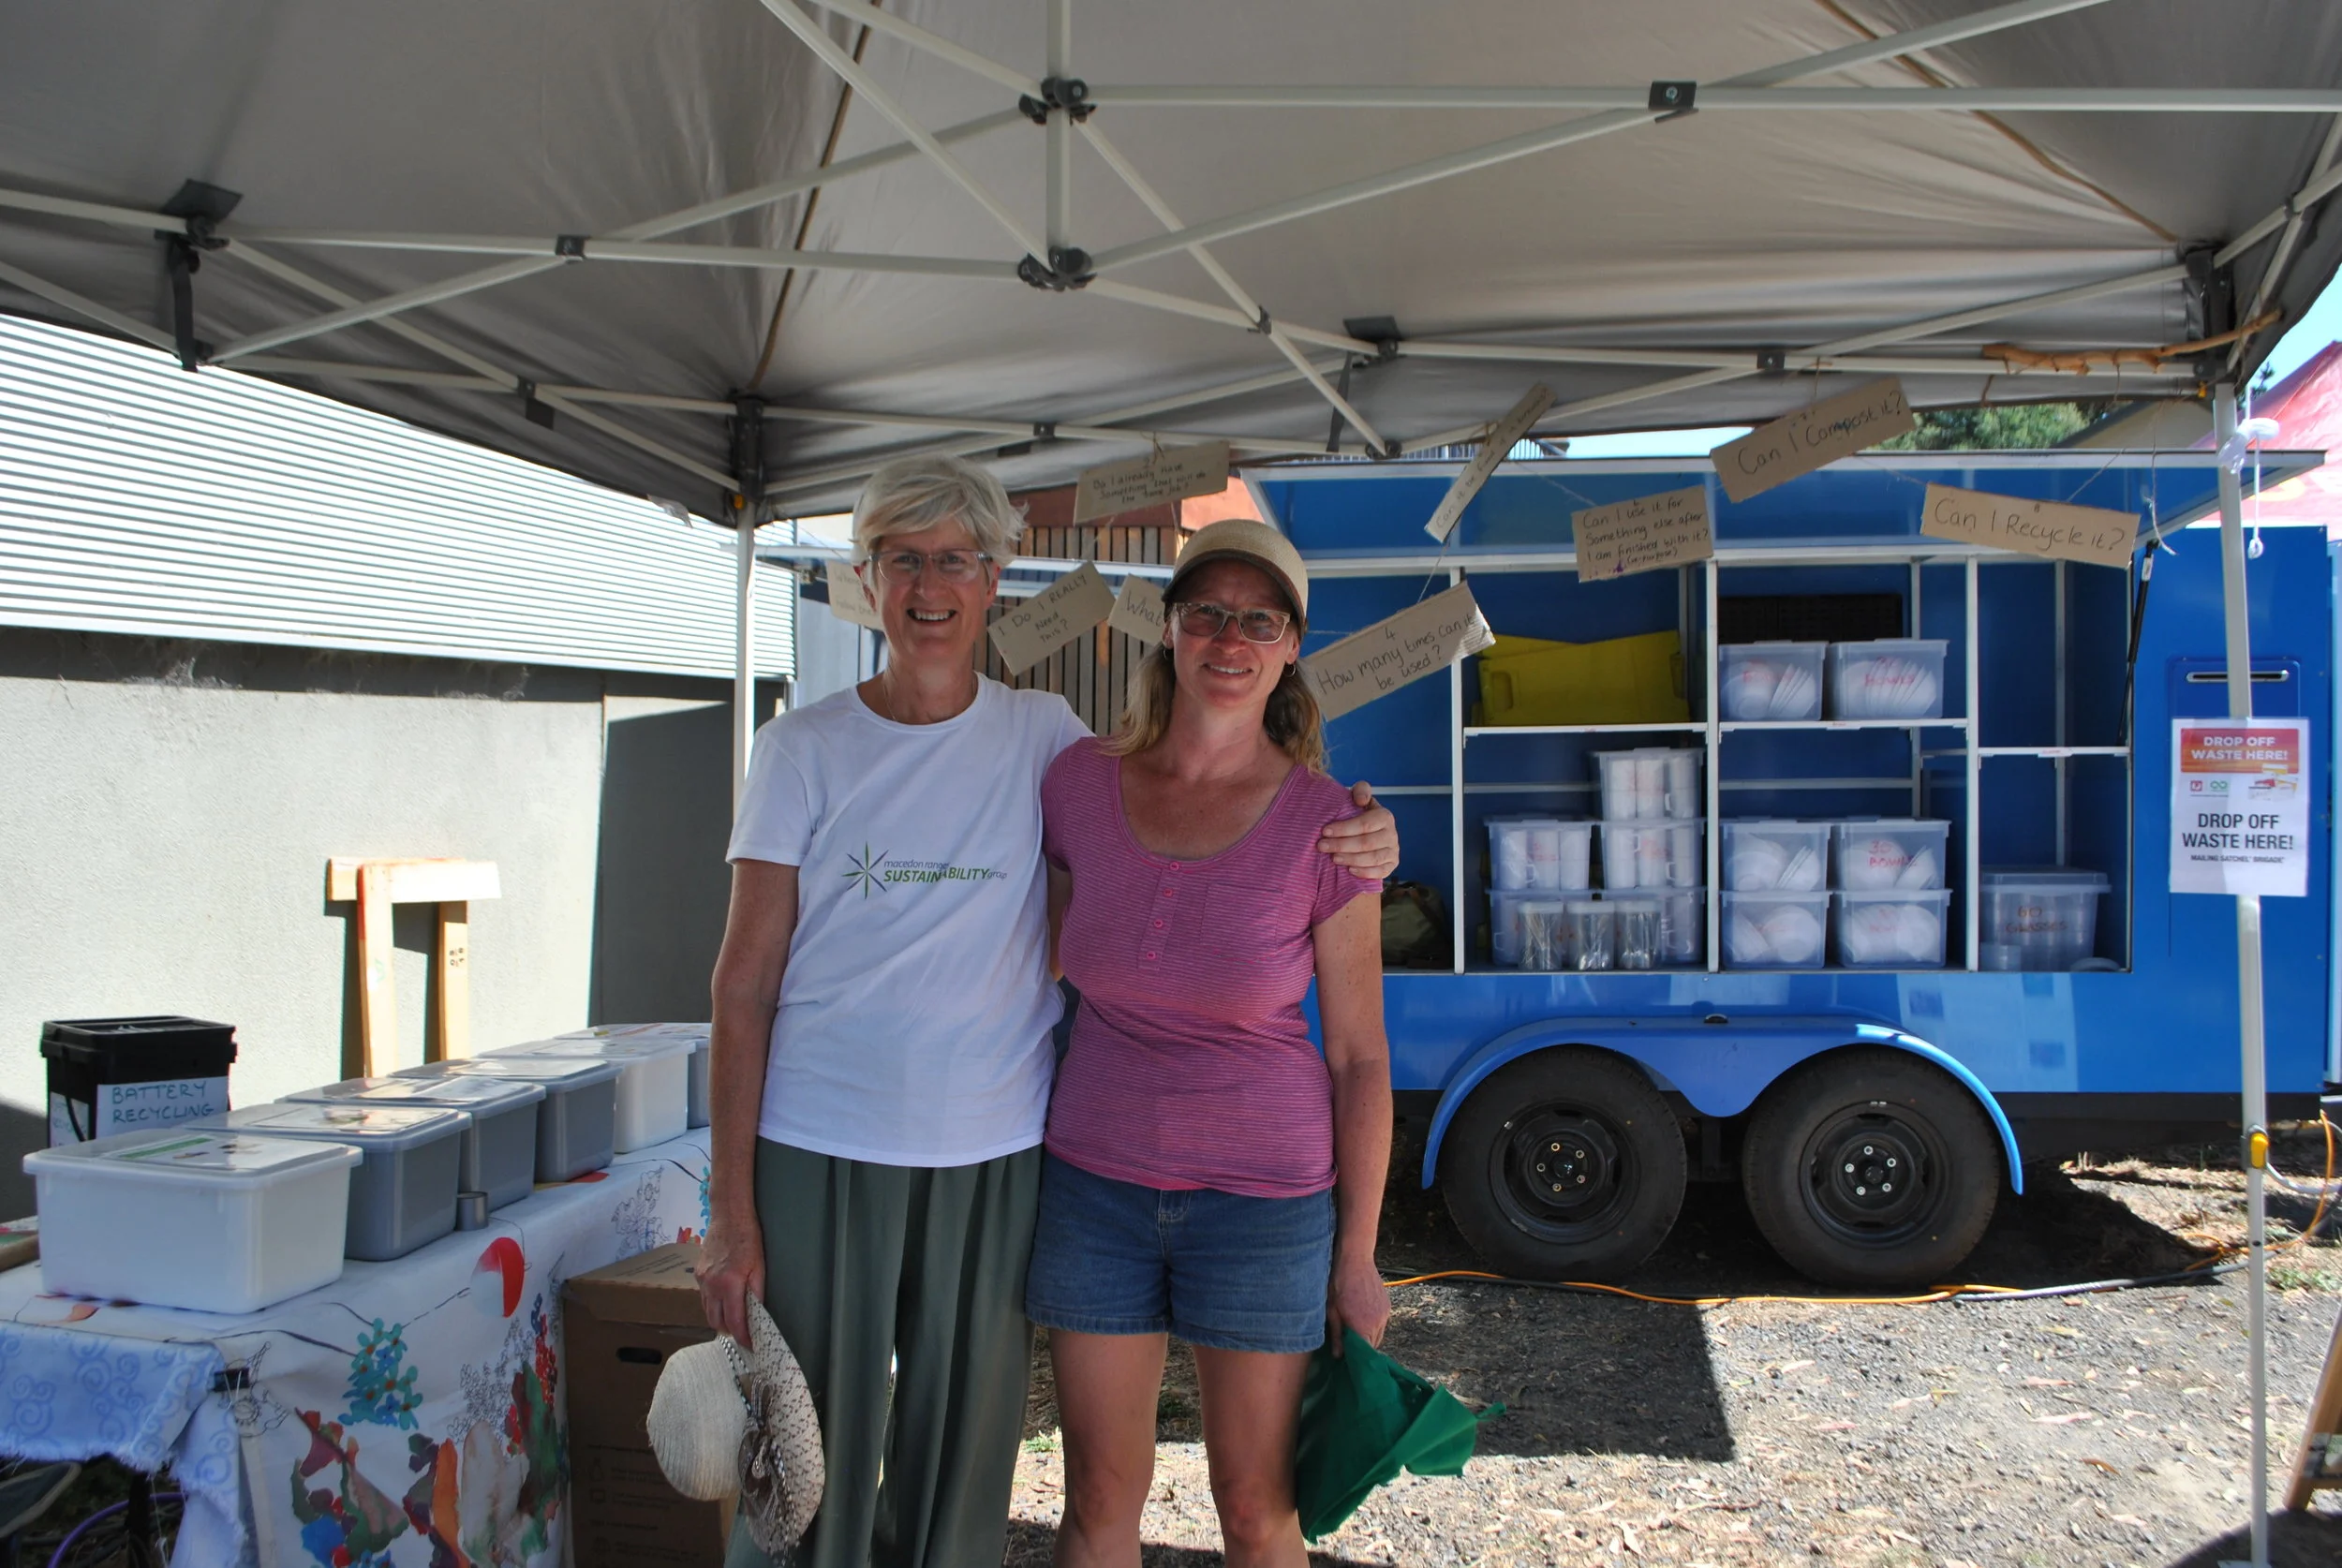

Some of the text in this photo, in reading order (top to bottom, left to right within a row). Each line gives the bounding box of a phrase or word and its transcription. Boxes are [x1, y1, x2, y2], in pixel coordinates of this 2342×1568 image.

[1738, 446, 1782, 475] Can
[1788, 431, 1798, 453] I
[1806, 407, 1878, 448] Compost
[1583, 496, 1684, 529] Can I use it for
[1653, 517, 1675, 530] else
[1678, 510, 1704, 527] after
[1934, 497, 1977, 529] Can
[1991, 510, 1996, 533] I
[2006, 513, 2083, 552] Recycle
[1595, 550, 1612, 561] am
[1618, 539, 1658, 557] finished
[1664, 534, 1689, 548] with
[1048, 574, 1088, 603] REALLY
[1126, 590, 1163, 628] What
[1035, 612, 1060, 631] Need
[1385, 627, 1395, 640] 4
[1316, 672, 1355, 695] How
[1358, 647, 1405, 676] many
[1405, 631, 1435, 653] times
[1464, 614, 1475, 630] it
[1375, 675, 1395, 690] be
[2203, 736, 2276, 747] DROP OFF
[2191, 750, 2289, 761] WASTE HERE!
[2198, 813, 2279, 829] DROP OFF
[2182, 833, 2293, 850] WASTE HERE!
[883, 859, 924, 868] macedon
[111, 1081, 207, 1104] BATTERY
[112, 1103, 215, 1123] RECYCLING
